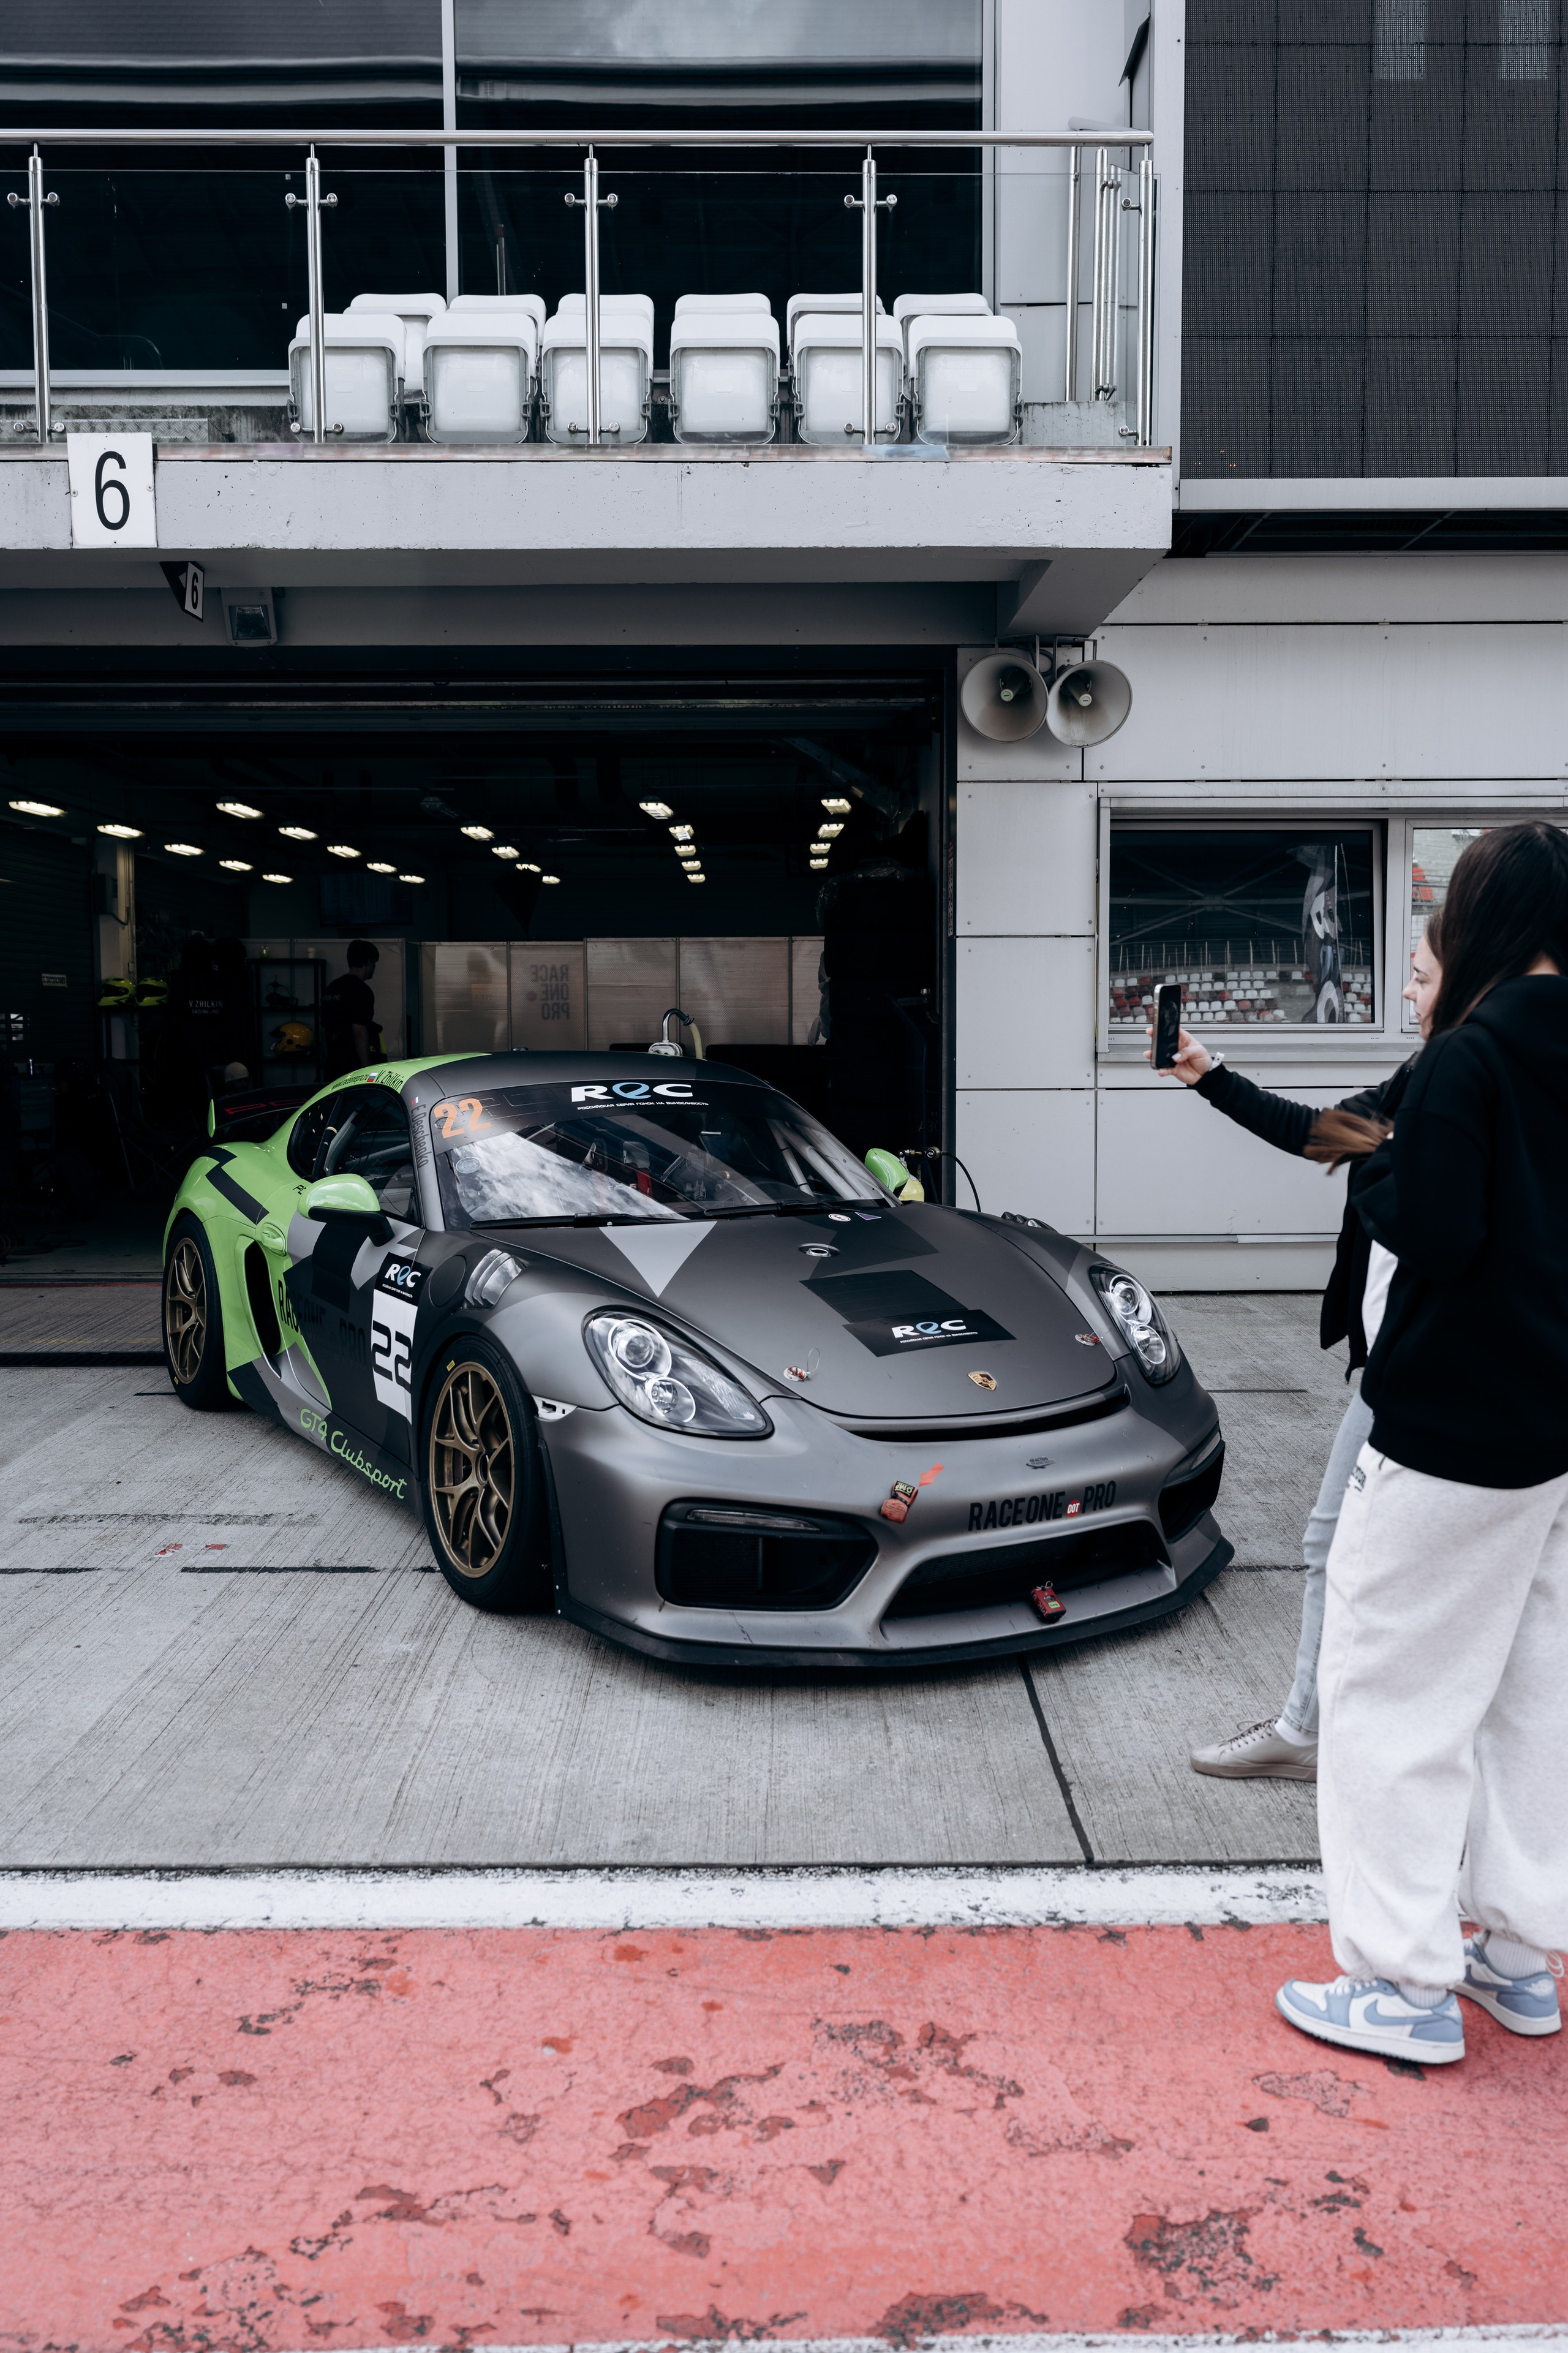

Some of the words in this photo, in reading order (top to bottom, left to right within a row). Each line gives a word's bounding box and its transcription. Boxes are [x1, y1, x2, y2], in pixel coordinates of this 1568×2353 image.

[95, 451, 130, 531] 6
[191, 572, 198, 610] 6
[380, 1071, 404, 1090] Zhilkin
[434, 1098, 492, 1139] 22
[372, 1320, 411, 1394] 22
[300, 1409, 328, 1440] GT4
[331, 1430, 407, 1499] Clubsport
[895, 1483, 913, 1494] OMP
[1067, 1503, 1080, 1514] DOT
[1082, 1480, 1116, 1514] PRO
